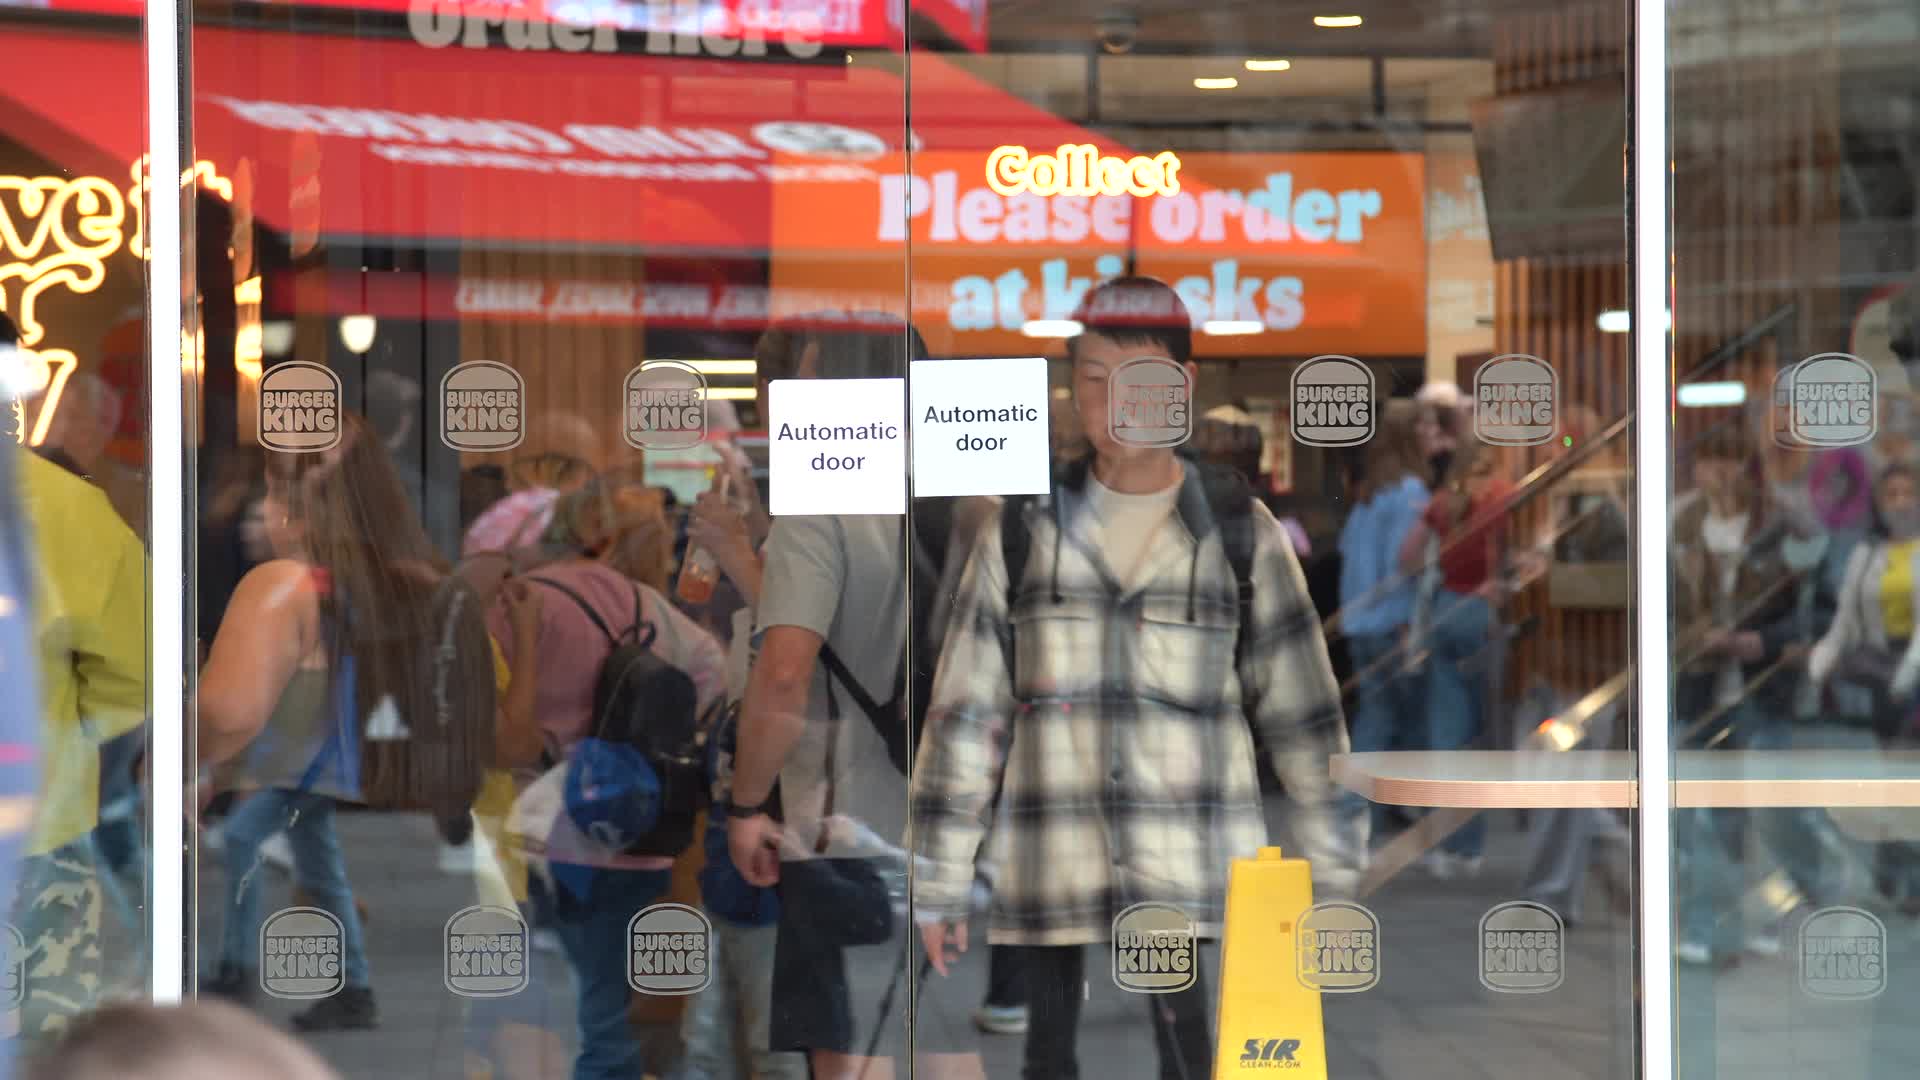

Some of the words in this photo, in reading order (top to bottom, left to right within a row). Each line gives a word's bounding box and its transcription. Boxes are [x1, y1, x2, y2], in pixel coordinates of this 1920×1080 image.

[985, 143, 1182, 197] Collect
[878, 170, 1132, 242] Please
[1150, 171, 1382, 243] order
[949, 268, 1027, 331] at
[263, 391, 335, 408] BURGER
[447, 391, 519, 408] BURGER
[629, 390, 702, 407] BURGER
[1296, 386, 1369, 402] BURGER
[1480, 384, 1552, 401] BURGER
[1796, 383, 1871, 401] BURGER
[263, 408, 336, 432] KING
[447, 407, 519, 431] KING
[629, 406, 702, 430] KING
[924, 404, 1038, 424] Automatic
[1296, 402, 1369, 426] KING
[1480, 401, 1552, 425] KING
[1796, 401, 1871, 425] KING
[778, 421, 898, 441] Automatic
[956, 433, 1008, 451] door
[811, 452, 866, 471] door
[266, 937, 339, 954] BURGER
[450, 935, 523, 952] BURGER
[634, 934, 706, 951] BURGER
[1119, 931, 1190, 949] BURGER
[1485, 932, 1558, 949] BURGER
[266, 954, 339, 978] KING
[450, 952, 523, 976] KING
[634, 950, 706, 974] KING
[1119, 949, 1191, 972] KING
[1302, 948, 1374, 972] KING
[1485, 948, 1558, 972] KING
[1239, 1038, 1301, 1061] SIR
